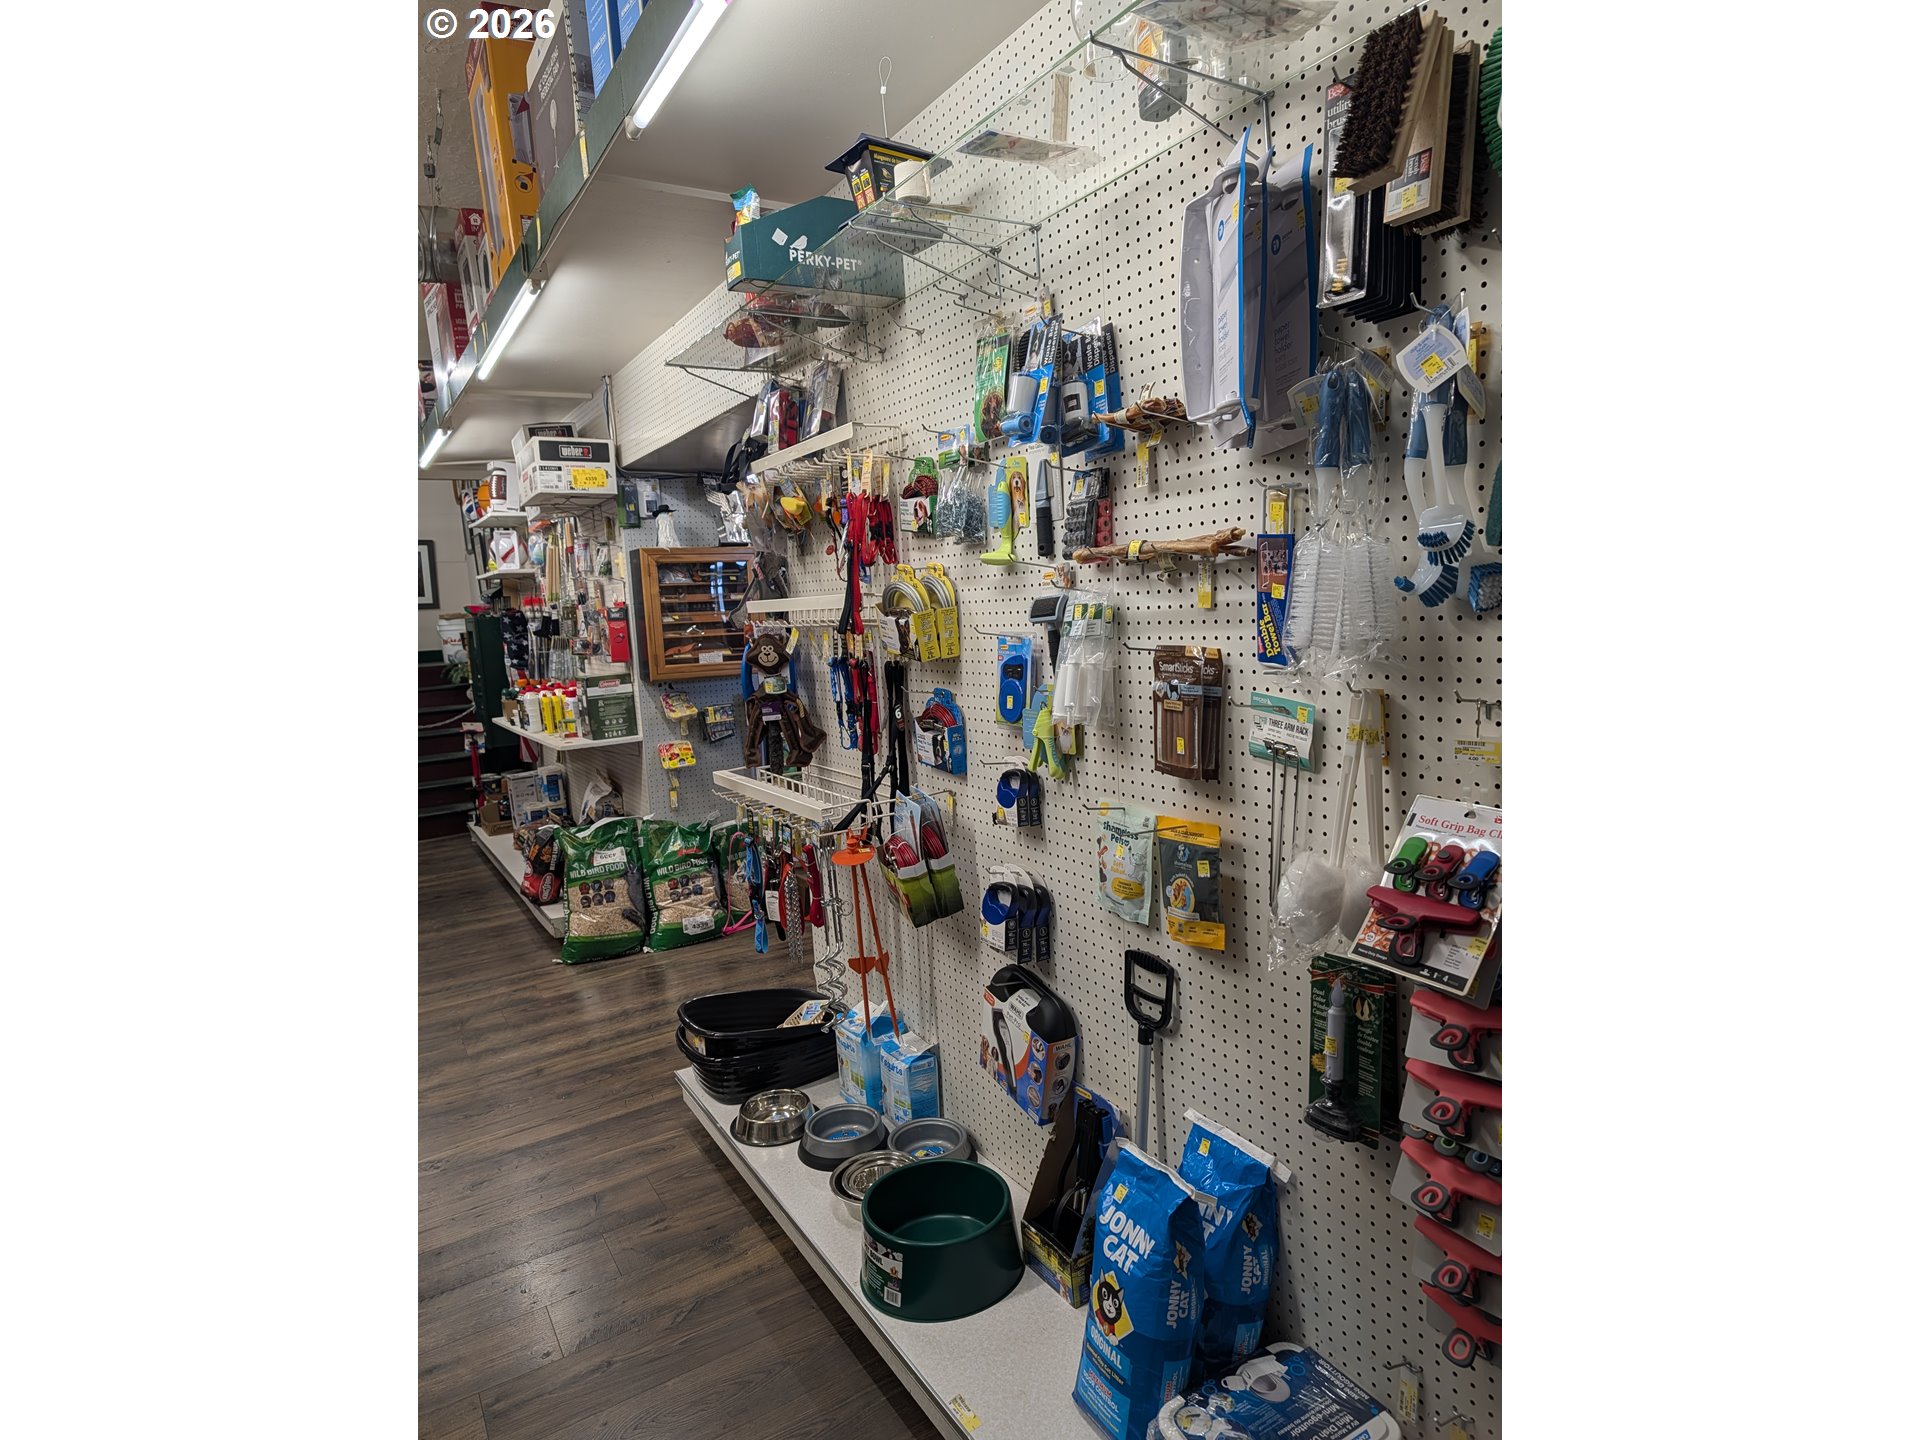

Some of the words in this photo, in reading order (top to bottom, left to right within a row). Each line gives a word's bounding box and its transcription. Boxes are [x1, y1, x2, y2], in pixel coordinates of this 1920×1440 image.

[1327, 116, 1350, 130] brus
[1043, 337, 1053, 366] Waste
[1048, 322, 1060, 364] Dispenser
[1105, 331, 1117, 374] Dispenser
[1086, 344, 1094, 372] Waste
[561, 446, 584, 457] weber
[1262, 603, 1271, 622] Bar
[1260, 619, 1275, 658] Double
[1266, 623, 1281, 656] Towel
[1159, 661, 1195, 674] SmartSticks
[1269, 718, 1284, 730] THREE
[1284, 722, 1296, 733] ARM
[1295, 725, 1309, 737] RACK
[1418, 815, 1440, 827] Soft
[1440, 819, 1465, 834] Grip
[1466, 824, 1487, 840] Bag
[586, 865, 604, 876] BIRD
[604, 862, 625, 872] FOOD
[656, 864, 674, 877] WILD
[649, 911, 657, 935] FOOD
[1375, 953, 1388, 961] Design
[1312, 987, 1325, 996] Dual
[1312, 994, 1327, 1003] Color
[1010, 1004, 1022, 1018] WAHL
[1312, 1008, 1329, 1018] Cand
[1055, 1043, 1072, 1051] WAHL
[1099, 1205, 1156, 1260] JONNY
[869, 1250, 884, 1267] BOWL
[1103, 1235, 1140, 1274] CAT
[1241, 1244, 1253, 1295] JONNY
[1252, 1258, 1262, 1285] CAT
[1166, 1279, 1183, 1330] JONNY
[1178, 1290, 1191, 1319] CAT
[1090, 1327, 1123, 1371] ORIGINAL
[1289, 1402, 1340, 1438] Mini-égouttoir
[1335, 1413, 1354, 1428] Mini
[1319, 1424, 1338, 1439] Dish
